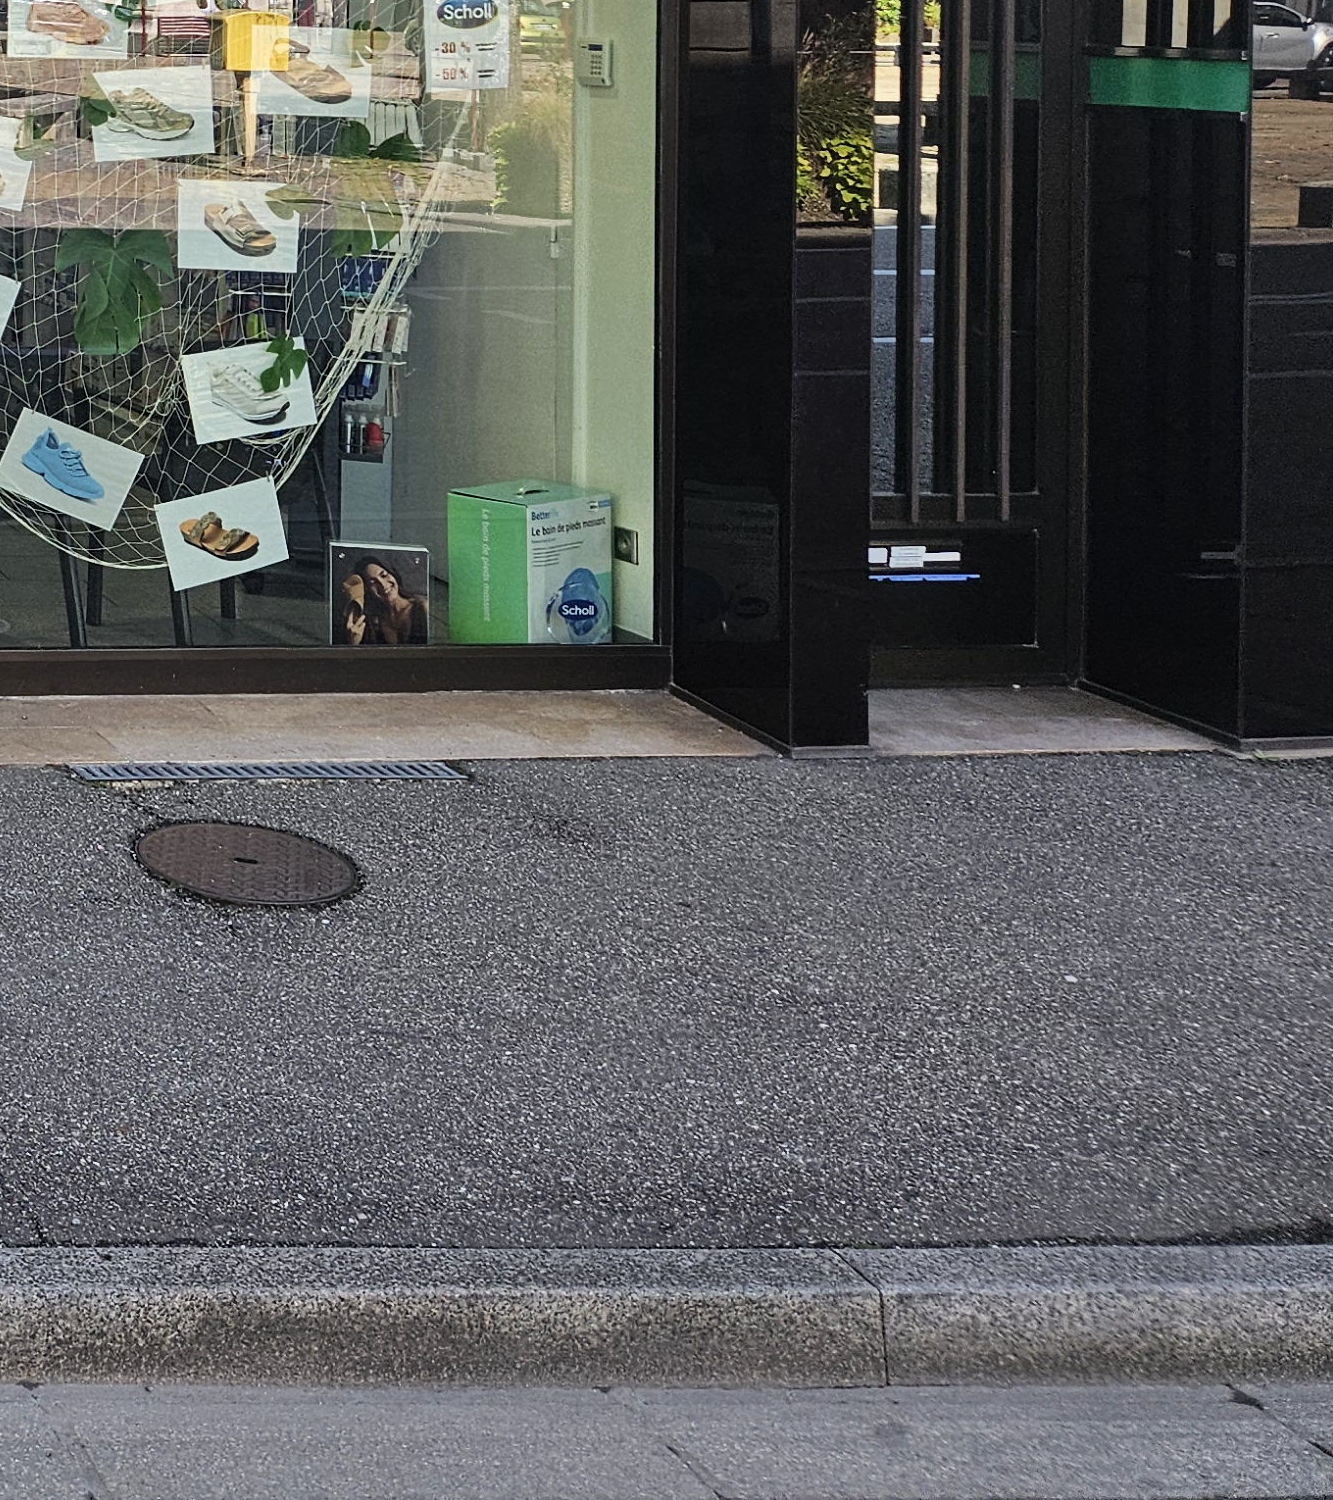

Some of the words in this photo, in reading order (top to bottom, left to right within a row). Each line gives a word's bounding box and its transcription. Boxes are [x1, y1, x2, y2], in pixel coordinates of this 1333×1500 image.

[443, 2, 493, 20] Scholl
[531, 527, 541, 537] Le
[542, 525, 556, 535] bain
[556, 522, 565, 532] de
[566, 520, 582, 533] pieds
[561, 605, 595, 616] Scholl
